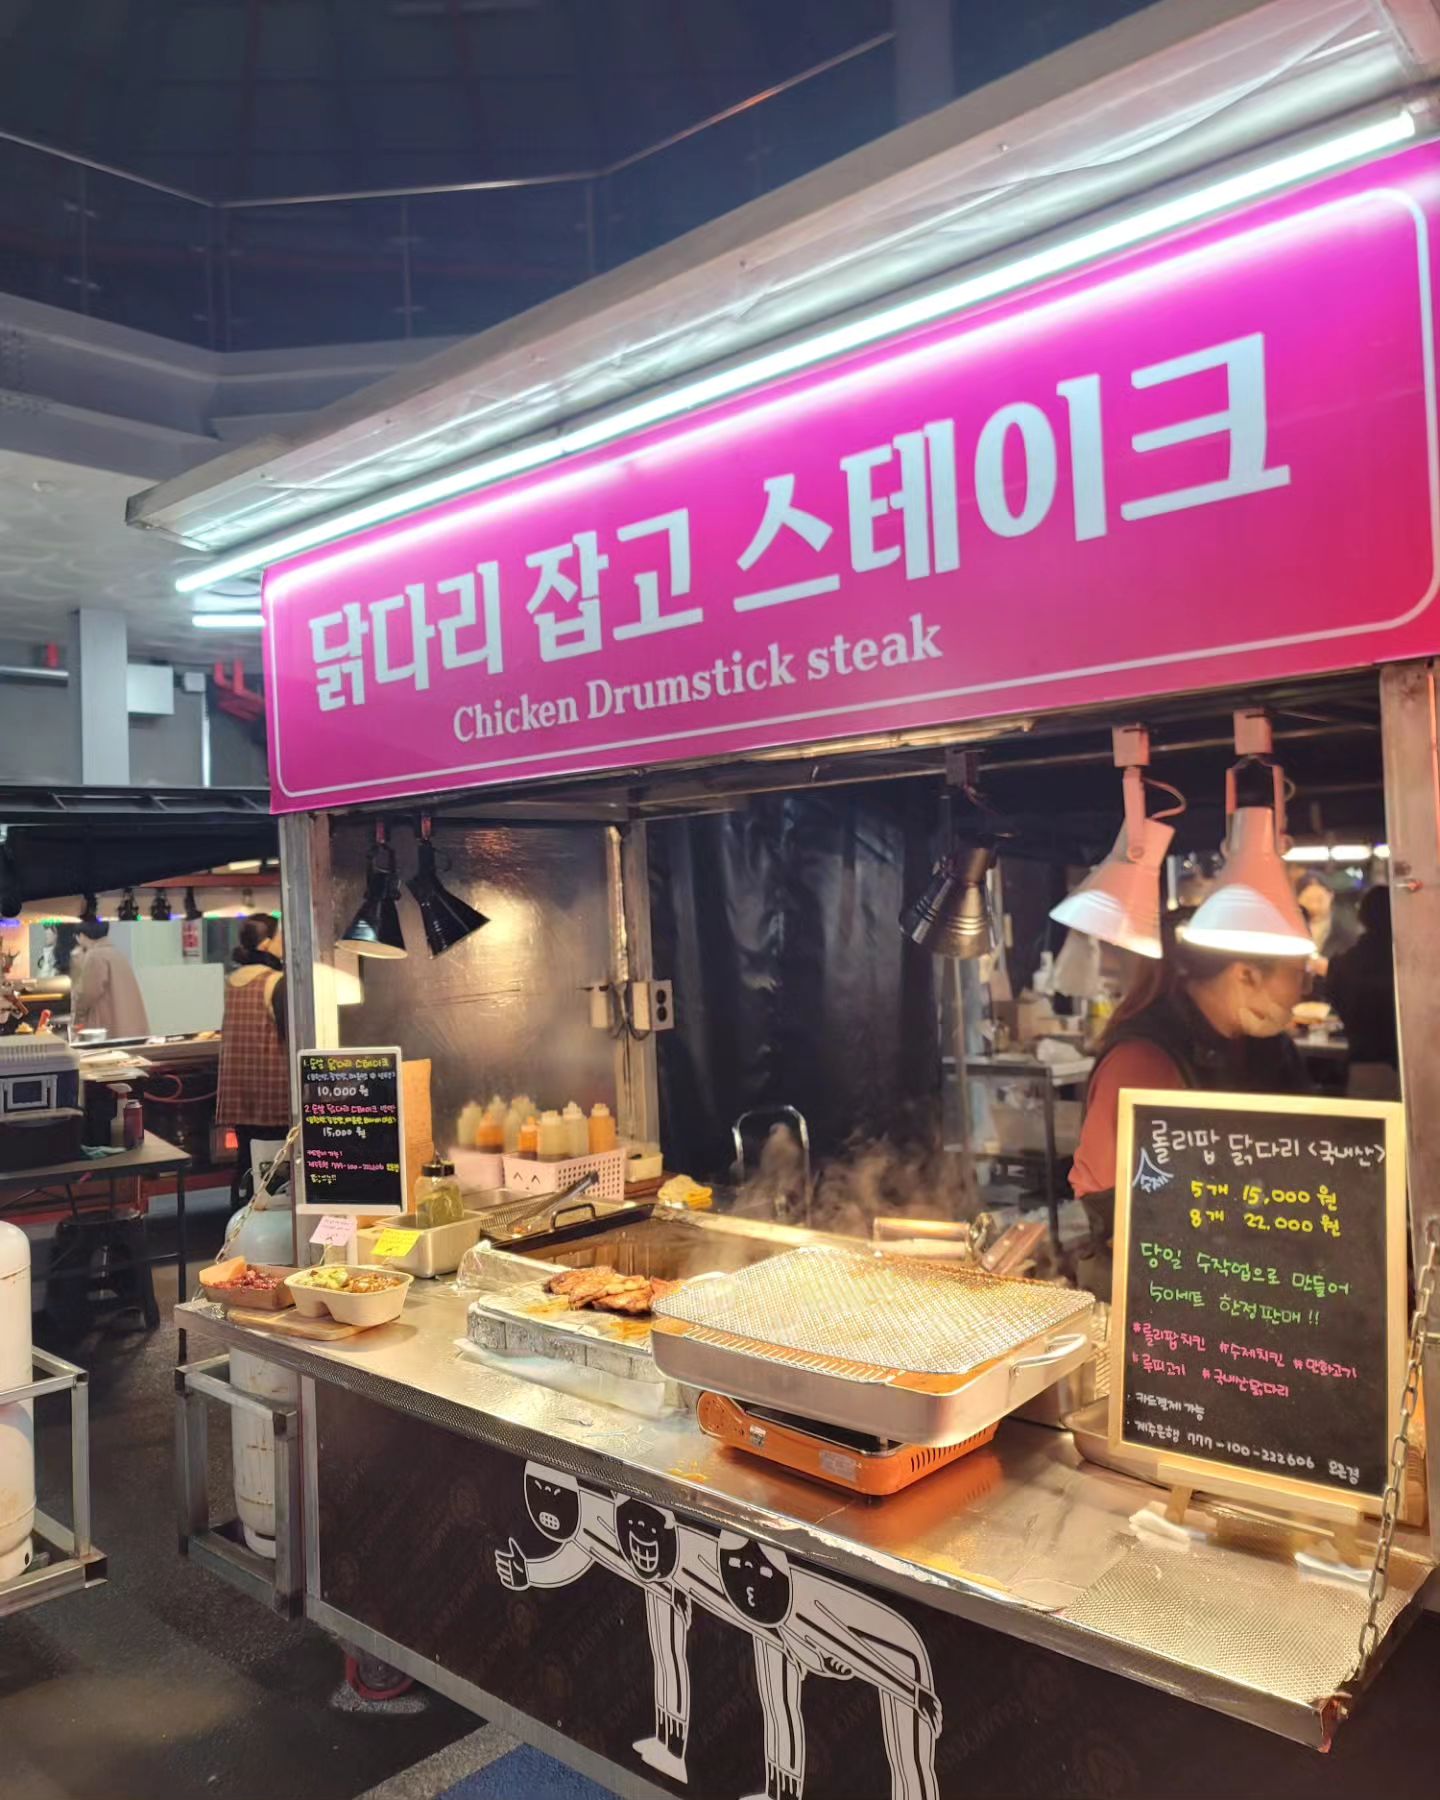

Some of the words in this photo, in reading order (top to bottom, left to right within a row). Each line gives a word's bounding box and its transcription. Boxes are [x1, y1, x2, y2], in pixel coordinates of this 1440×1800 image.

[308, 560, 504, 712] 닭다리
[525, 508, 704, 663] 잡고
[733, 332, 1291, 613] 스테이크
[453, 694, 579, 743] Chicken
[586, 643, 796, 719] Drumstick
[807, 612, 943, 681] steak
[317, 1087, 357, 1097] 10,000
[322, 1127, 353, 1138] 15,000
[1151, 1120, 1221, 1165] 롤리팝
[1228, 1133, 1300, 1167] 닭다리
[1140, 1242, 1182, 1270] 당일
[1196, 1252, 1280, 1285] 수작업으로
[1292, 1272, 1350, 1298] 만들어
[1149, 1281, 1205, 1307] 50세트
[1183, 1403, 1205, 1422] 가능
